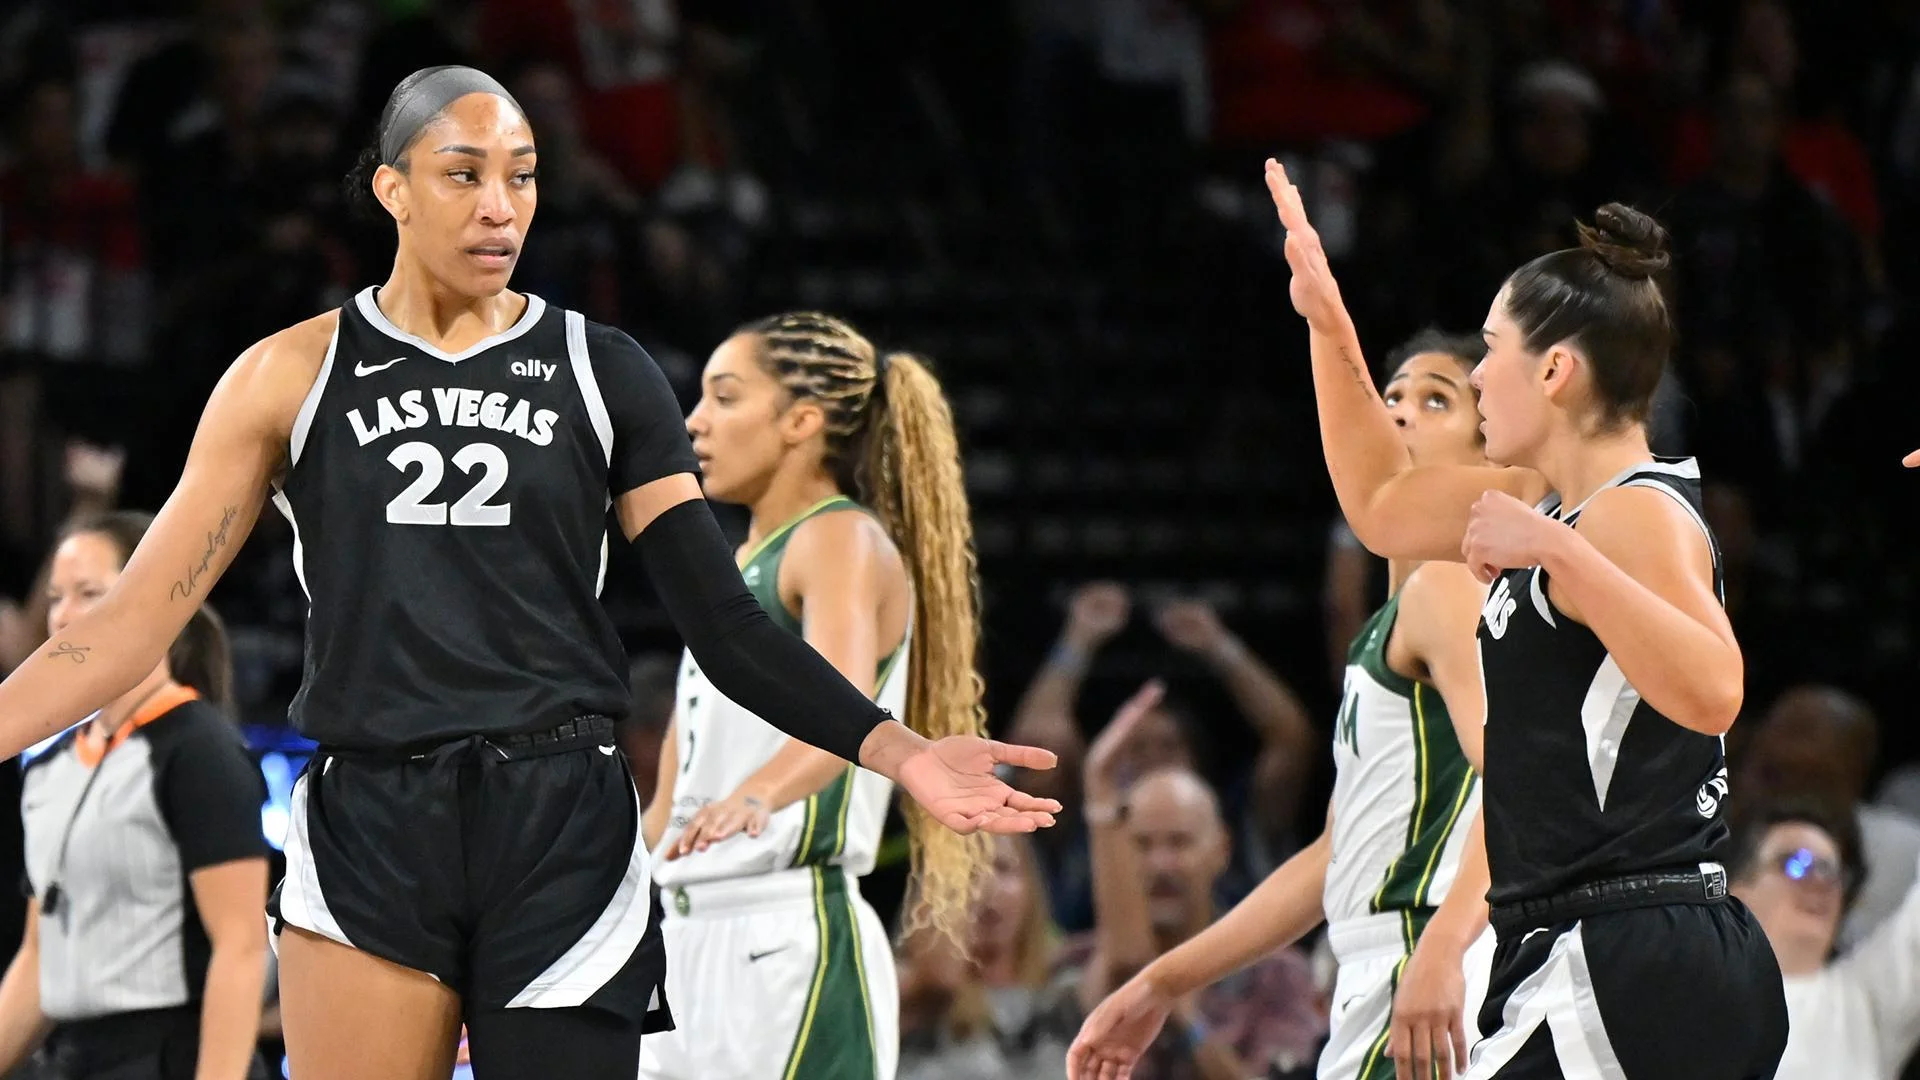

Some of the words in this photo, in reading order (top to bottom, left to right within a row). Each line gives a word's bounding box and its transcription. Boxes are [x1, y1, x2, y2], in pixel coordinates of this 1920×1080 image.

[510, 359, 557, 382] ally
[346, 389, 429, 447] LAS
[432, 387, 559, 447] VEGAS
[386, 441, 511, 526] 22
